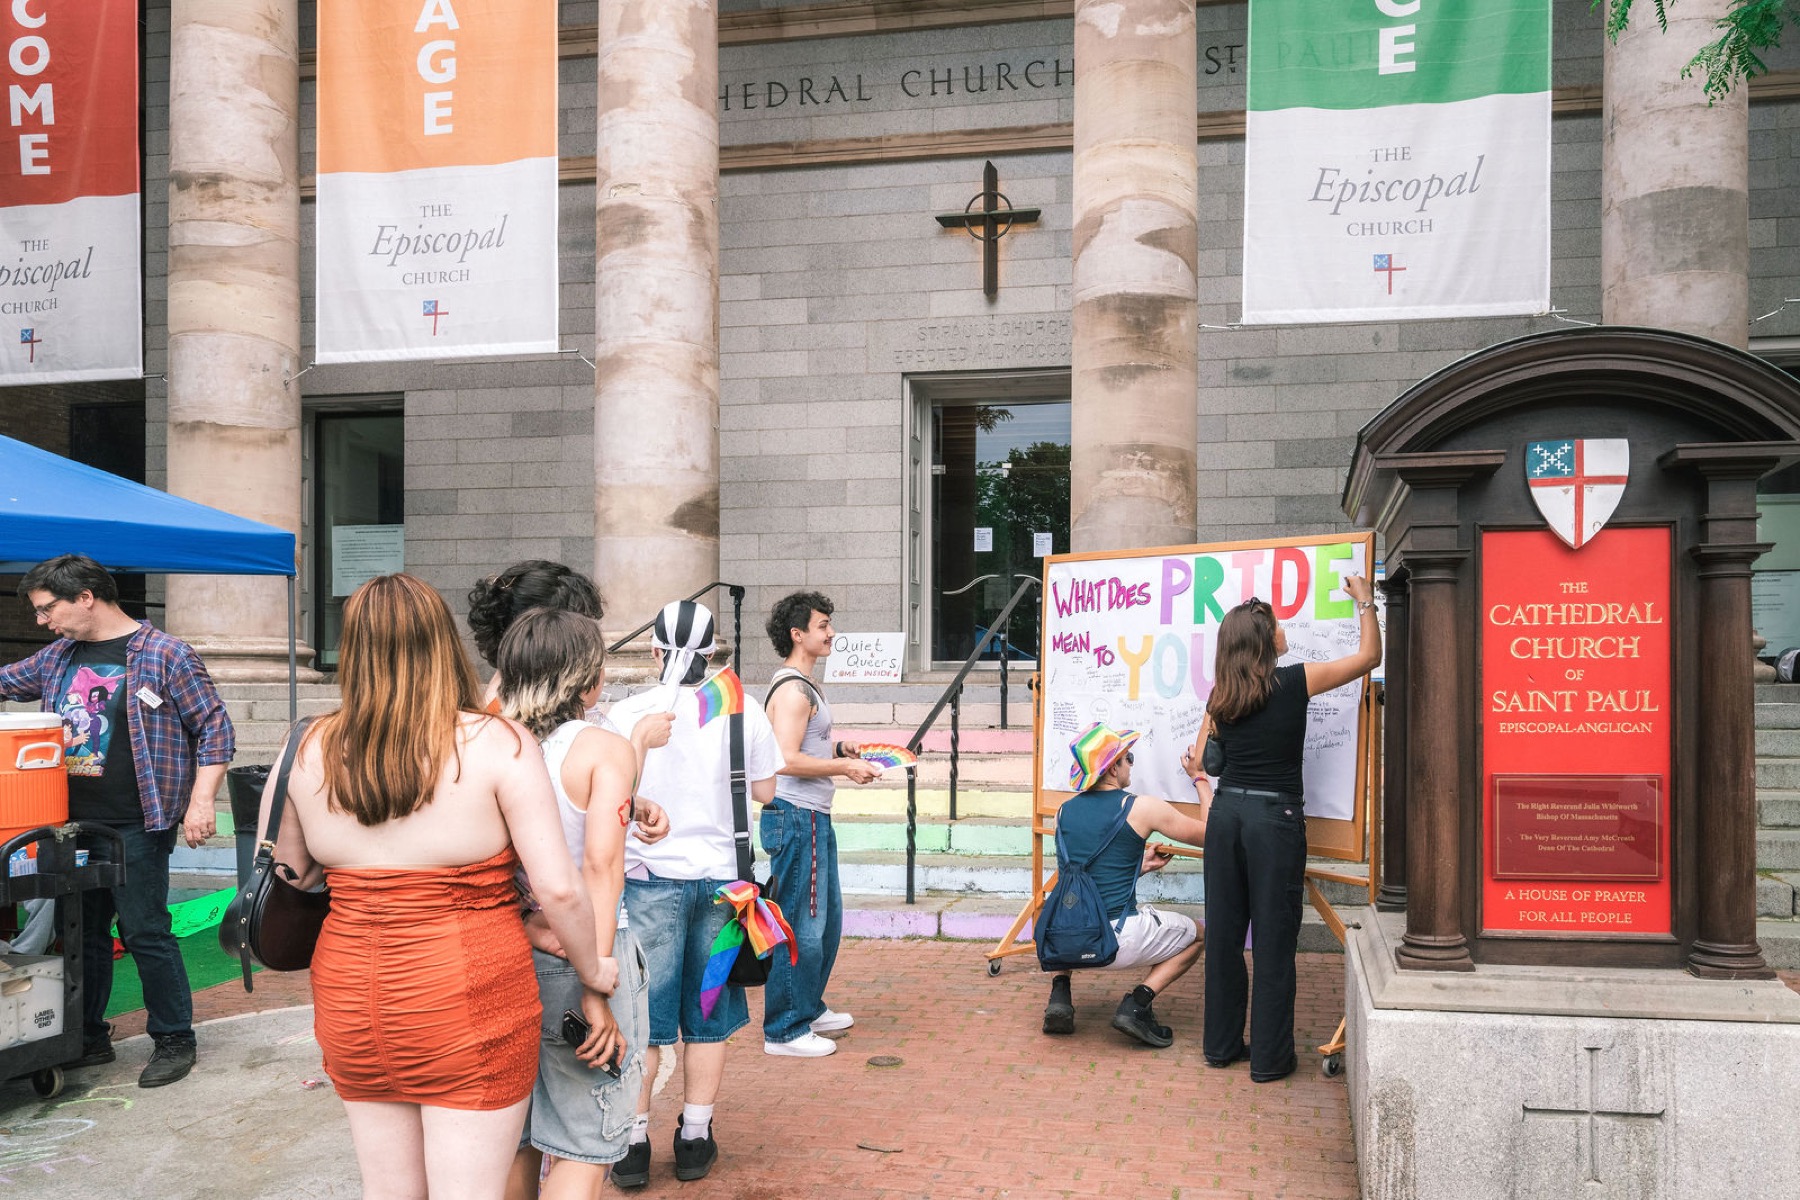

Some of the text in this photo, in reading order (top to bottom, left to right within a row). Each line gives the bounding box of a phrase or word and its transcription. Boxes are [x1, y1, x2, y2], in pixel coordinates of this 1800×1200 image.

[413, 0, 460, 136] AGE
[901, 59, 1075, 98] CHURCH
[8, 0, 54, 175] COME
[1369, 146, 1412, 162] THE
[1307, 154, 1485, 216] Episcopal
[419, 204, 453, 218] THE
[1346, 218, 1433, 237] CHURCH
[20, 239, 50, 252] THE
[368, 214, 508, 267] Episcopal
[402, 269, 470, 285] CHURCH
[1, 298, 58, 315] CHURCH
[1052, 542, 1355, 625] WHAT DOES PRIDE
[1560, 582, 1588, 594] THE
[1489, 602, 1663, 625] CATHEDRAL
[834, 636, 884, 652] Quiet
[1052, 631, 1091, 654] MEAN
[1093, 645, 1115, 668] TO
[1510, 636, 1641, 659] CHURCH
[846, 654, 897, 668] Queers
[1564, 669, 1585, 681] OF
[1492, 690, 1659, 712] SAINT PAUL
[1499, 722, 1653, 733] EPISCOPAL-ANGLICAN
[1536, 813, 1558, 821] Bishop
[1534, 834, 1549, 842] Very
[1504, 889, 1647, 902] A HOUSE OF PRAYER
[1519, 910, 1632, 924] FOR ALL PEOPLE
